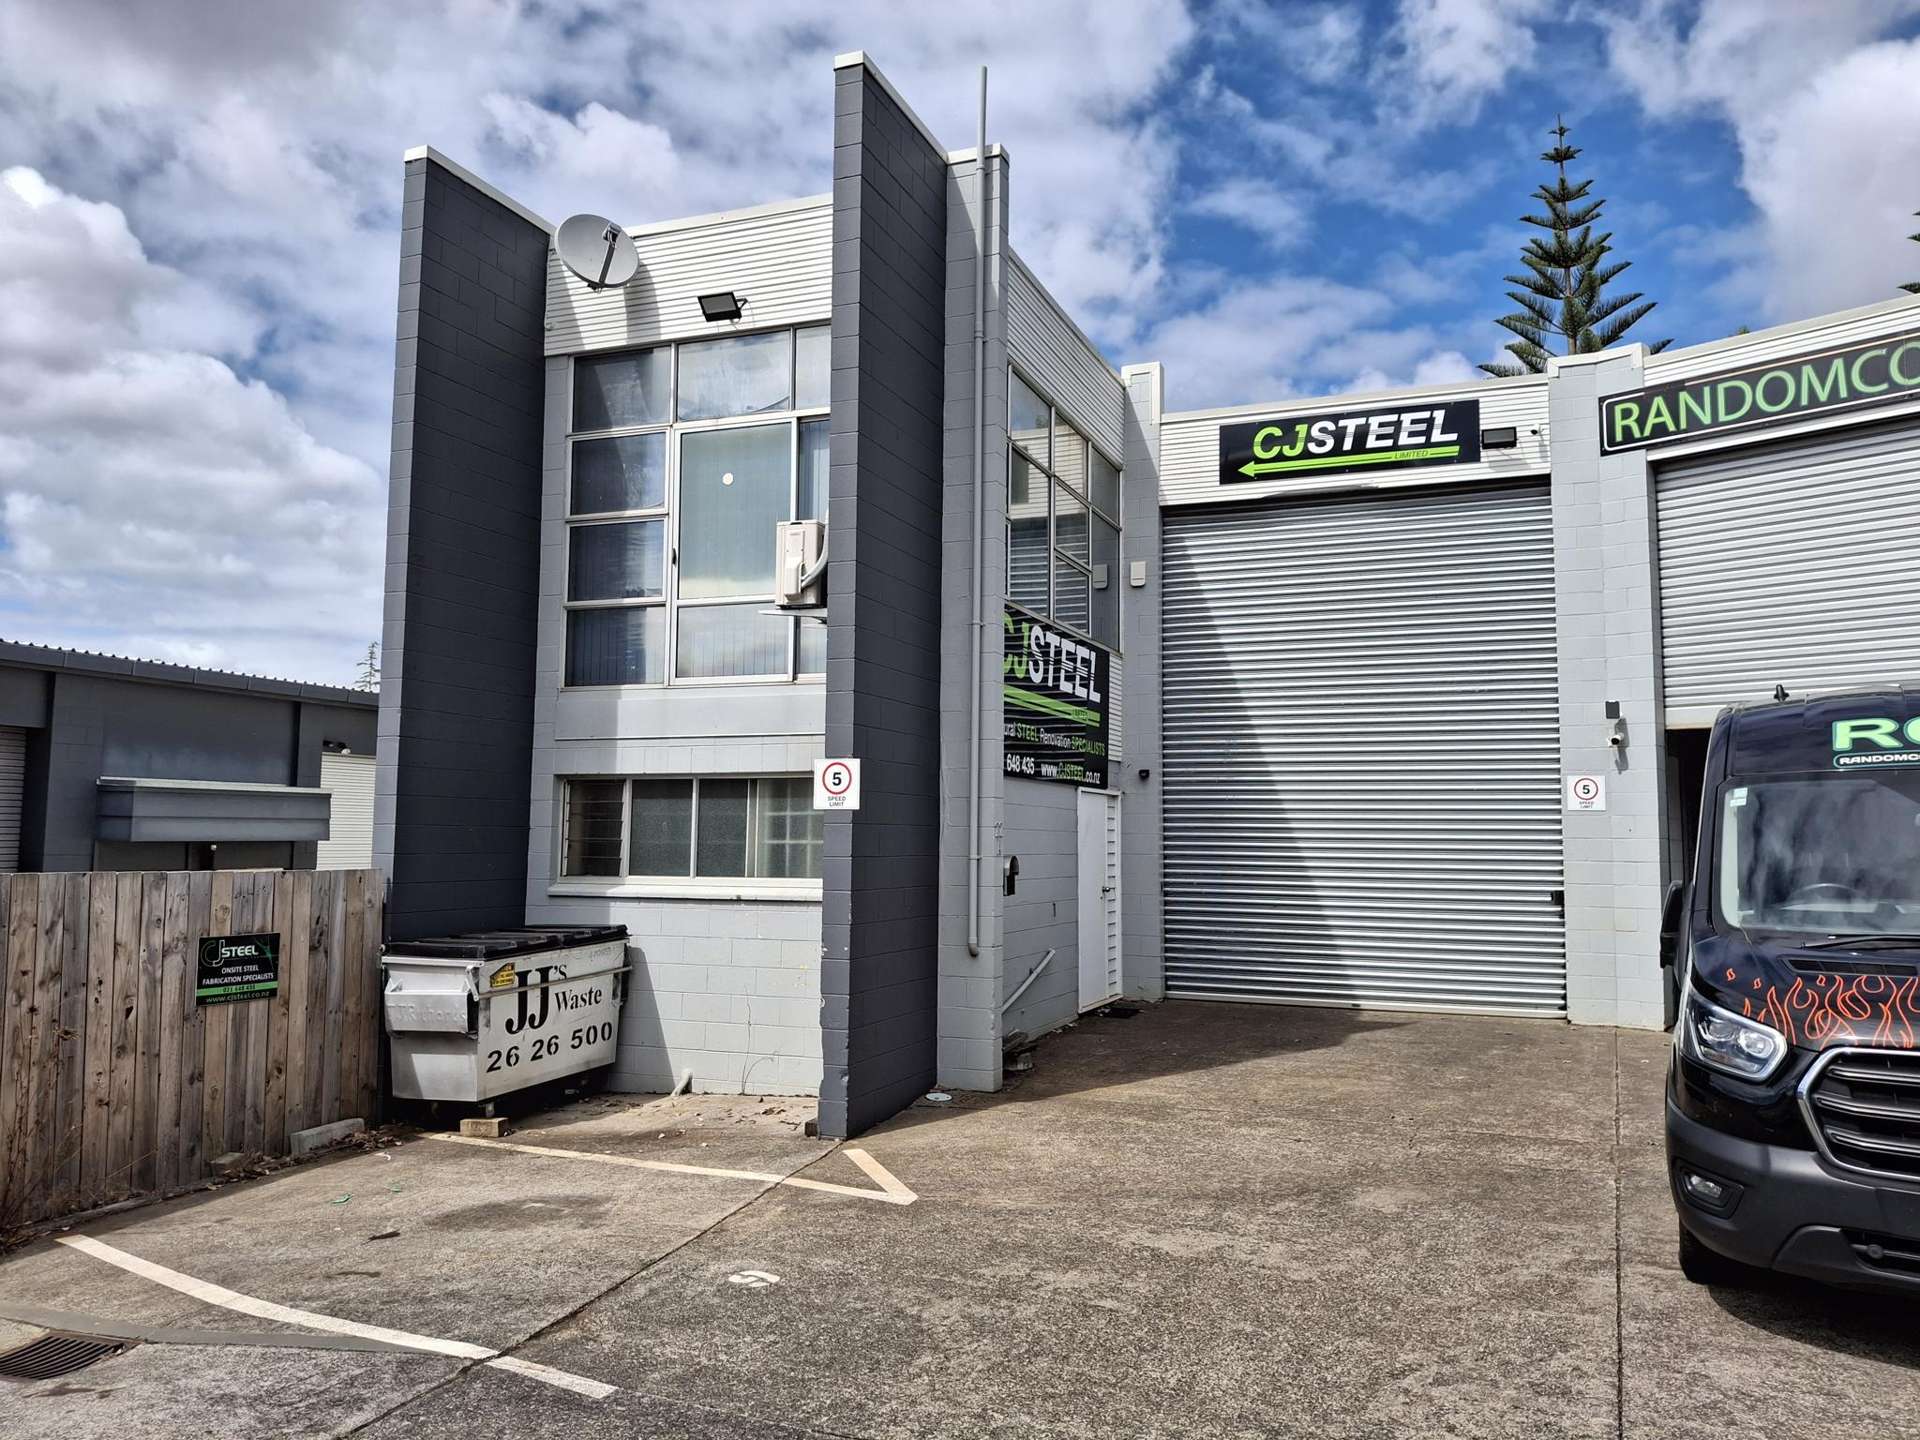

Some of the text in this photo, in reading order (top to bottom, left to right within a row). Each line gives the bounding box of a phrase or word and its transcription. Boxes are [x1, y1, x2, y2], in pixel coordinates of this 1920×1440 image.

[1252, 408, 1459, 460] CJSTEEL
[1394, 449, 1429, 460] LIMITED
[1016, 722, 1039, 742] STEEL
[1832, 716, 1920, 752] R
[1006, 753, 1021, 773] 648
[1021, 756, 1035, 775] 435
[1839, 753, 1920, 765] RANDOMC
[832, 771, 843, 787] 5
[1582, 784, 1591, 795] 5
[221, 944, 260, 958] STEEL
[221, 964, 259, 974] ONSITE STEEL
[202, 972, 274, 985] FABRICATION SPECIALISTS
[554, 986, 603, 1013] Waste
[486, 1021, 613, 1074] 26 26 500
